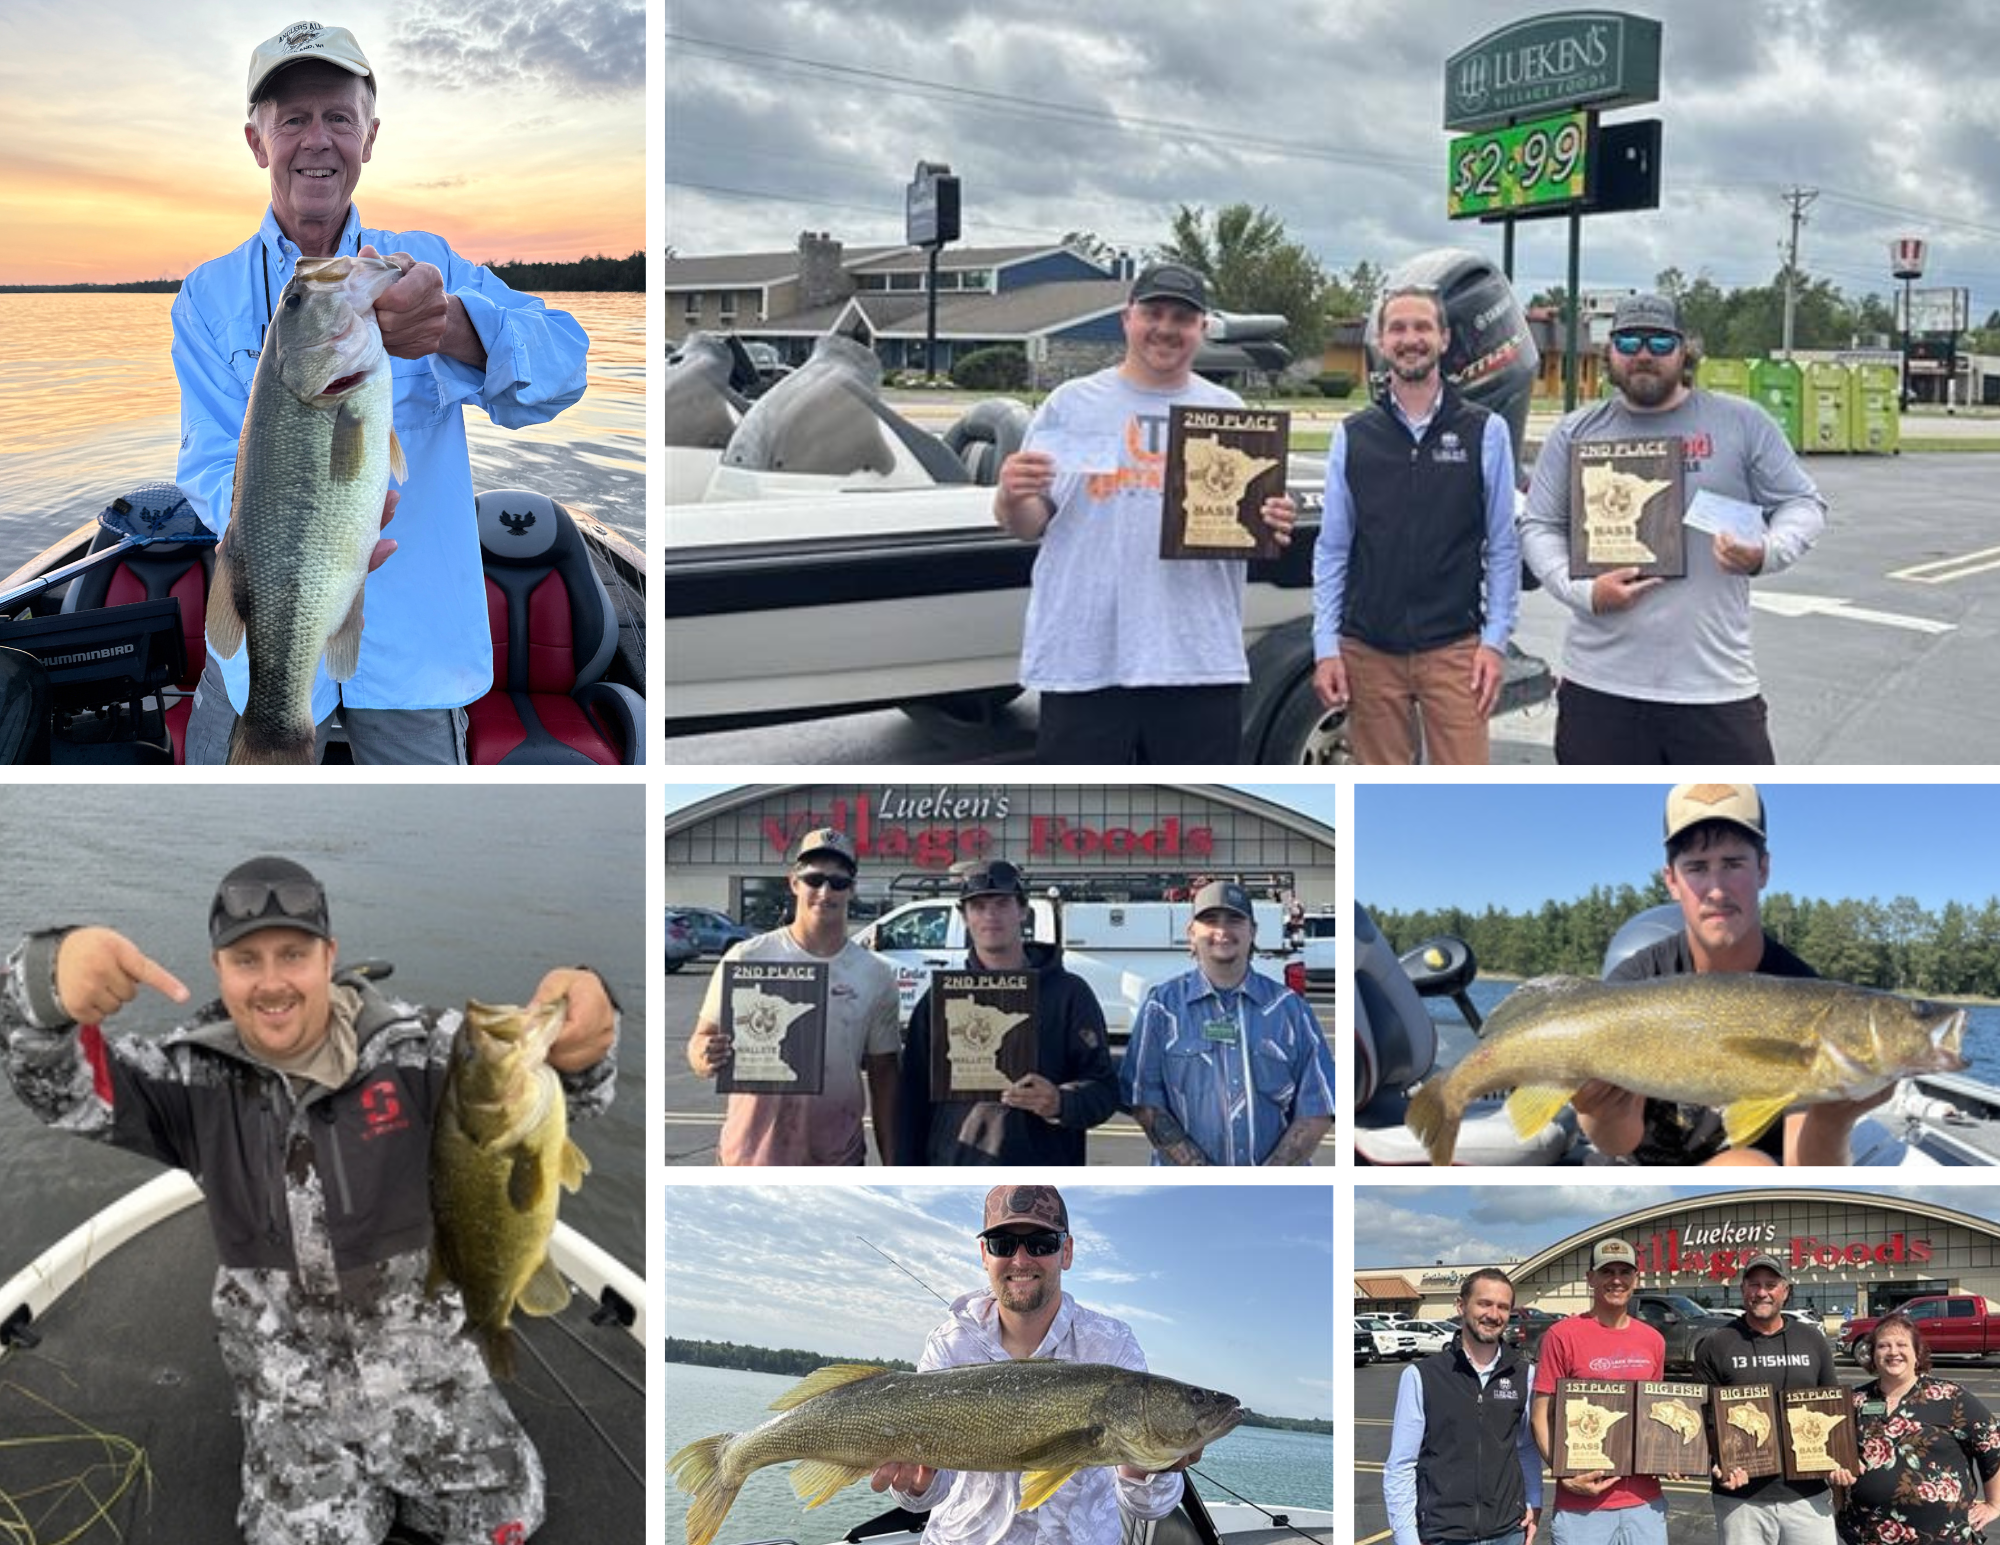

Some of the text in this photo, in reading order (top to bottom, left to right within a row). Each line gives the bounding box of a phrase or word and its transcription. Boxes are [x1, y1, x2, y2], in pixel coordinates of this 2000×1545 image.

[278, 23, 308, 44] ANGLERS
[1495, 25, 1607, 88] LUEKEN'S
[1183, 412, 1278, 432] 2ND PLACE
[1580, 440, 1668, 457] 2ND PLACE
[39, 643, 134, 667] HUMMINBIRD
[878, 786, 1010, 819] Lueken's
[761, 791, 1213, 870] Vllage Foods
[732, 966, 816, 980] 2ND PLACE
[943, 976, 1027, 989] 2ND PLACE
[1683, 1219, 1776, 1246] Lueken's
[1632, 1228, 1934, 1280] illage Foods
[1731, 1354, 1811, 1369] 13 FISHING
[1566, 1383, 1626, 1393] 1ST PLACE
[1645, 1383, 1703, 1397] BIG FISH
[1720, 1386, 1770, 1400] BIG FISH
[1787, 1389, 1843, 1402] 1ST PLACE
[1800, 1446, 1824, 1454] BASS
